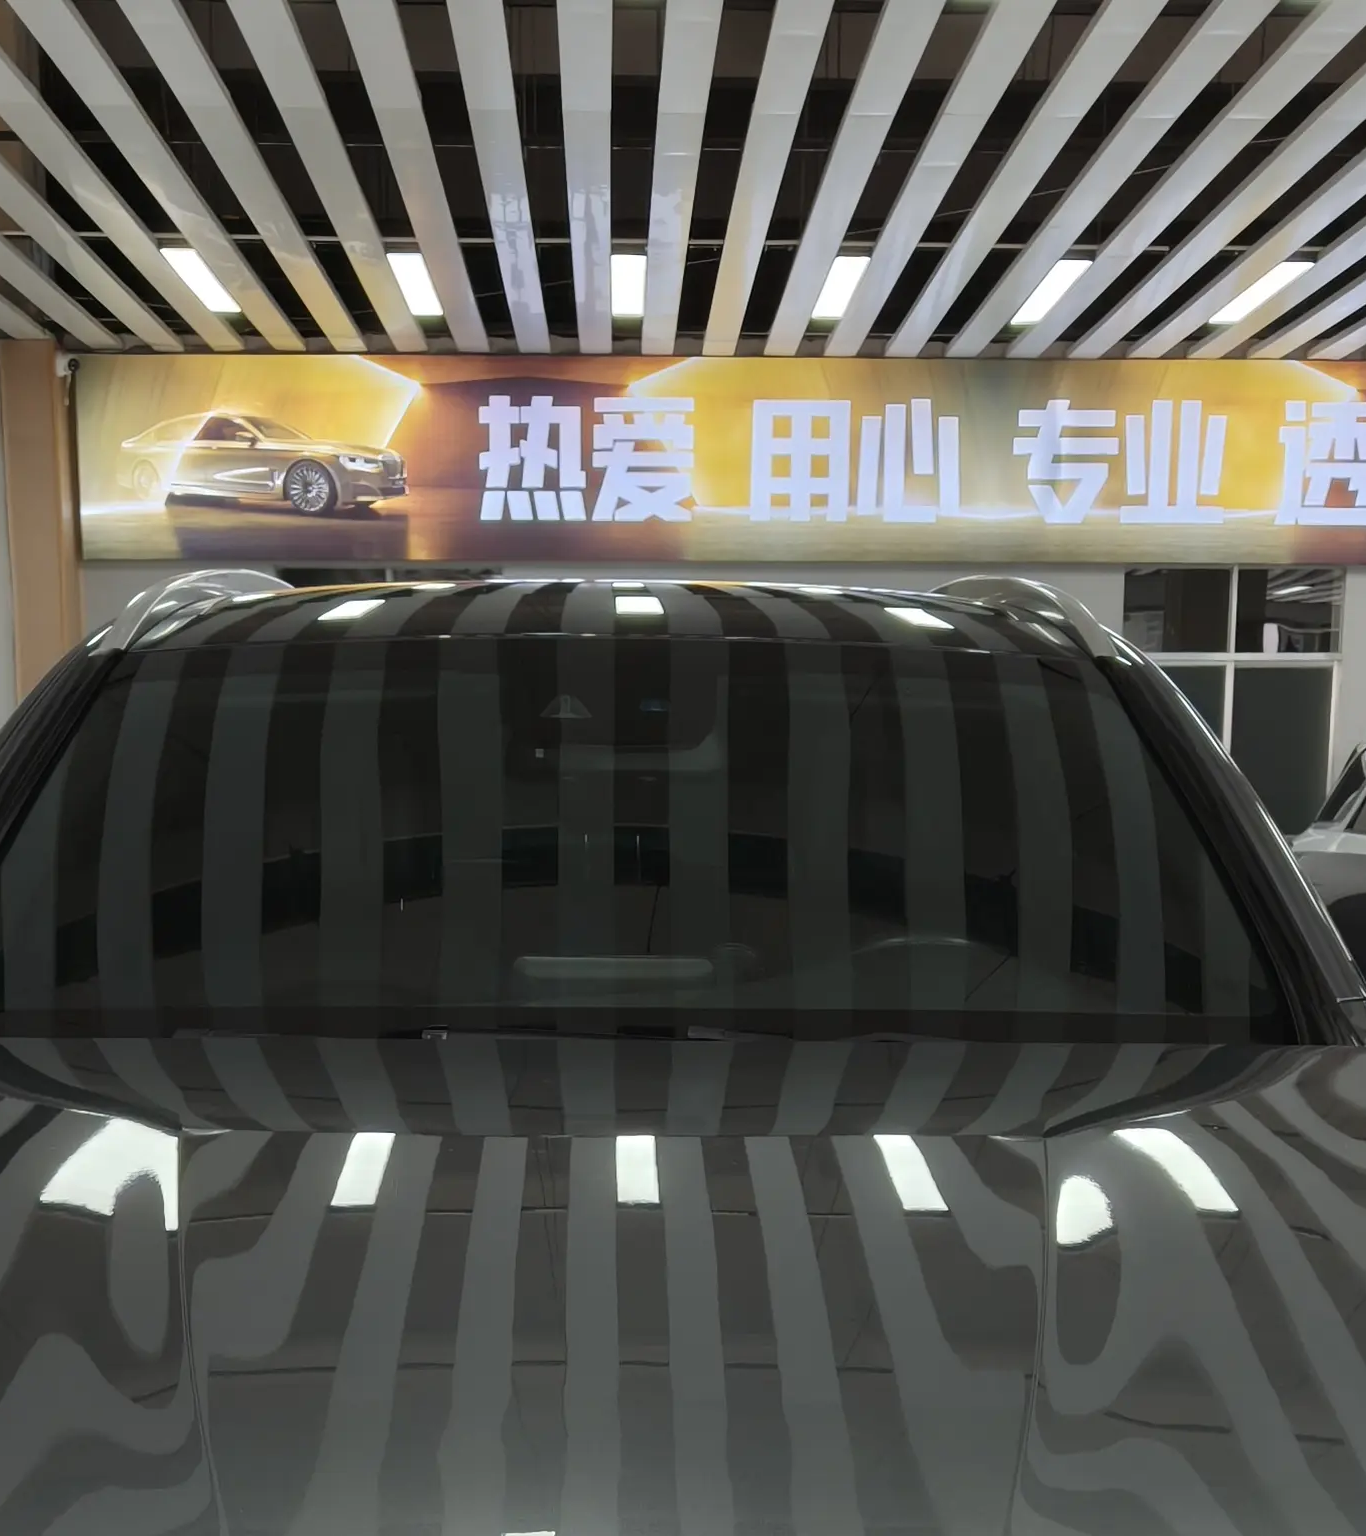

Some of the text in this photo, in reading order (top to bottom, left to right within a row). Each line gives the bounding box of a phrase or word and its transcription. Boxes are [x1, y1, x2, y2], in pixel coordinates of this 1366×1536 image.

[479, 395, 694, 522] 热爱
[749, 399, 960, 522] 用心
[1012, 399, 1228, 524] 专业
